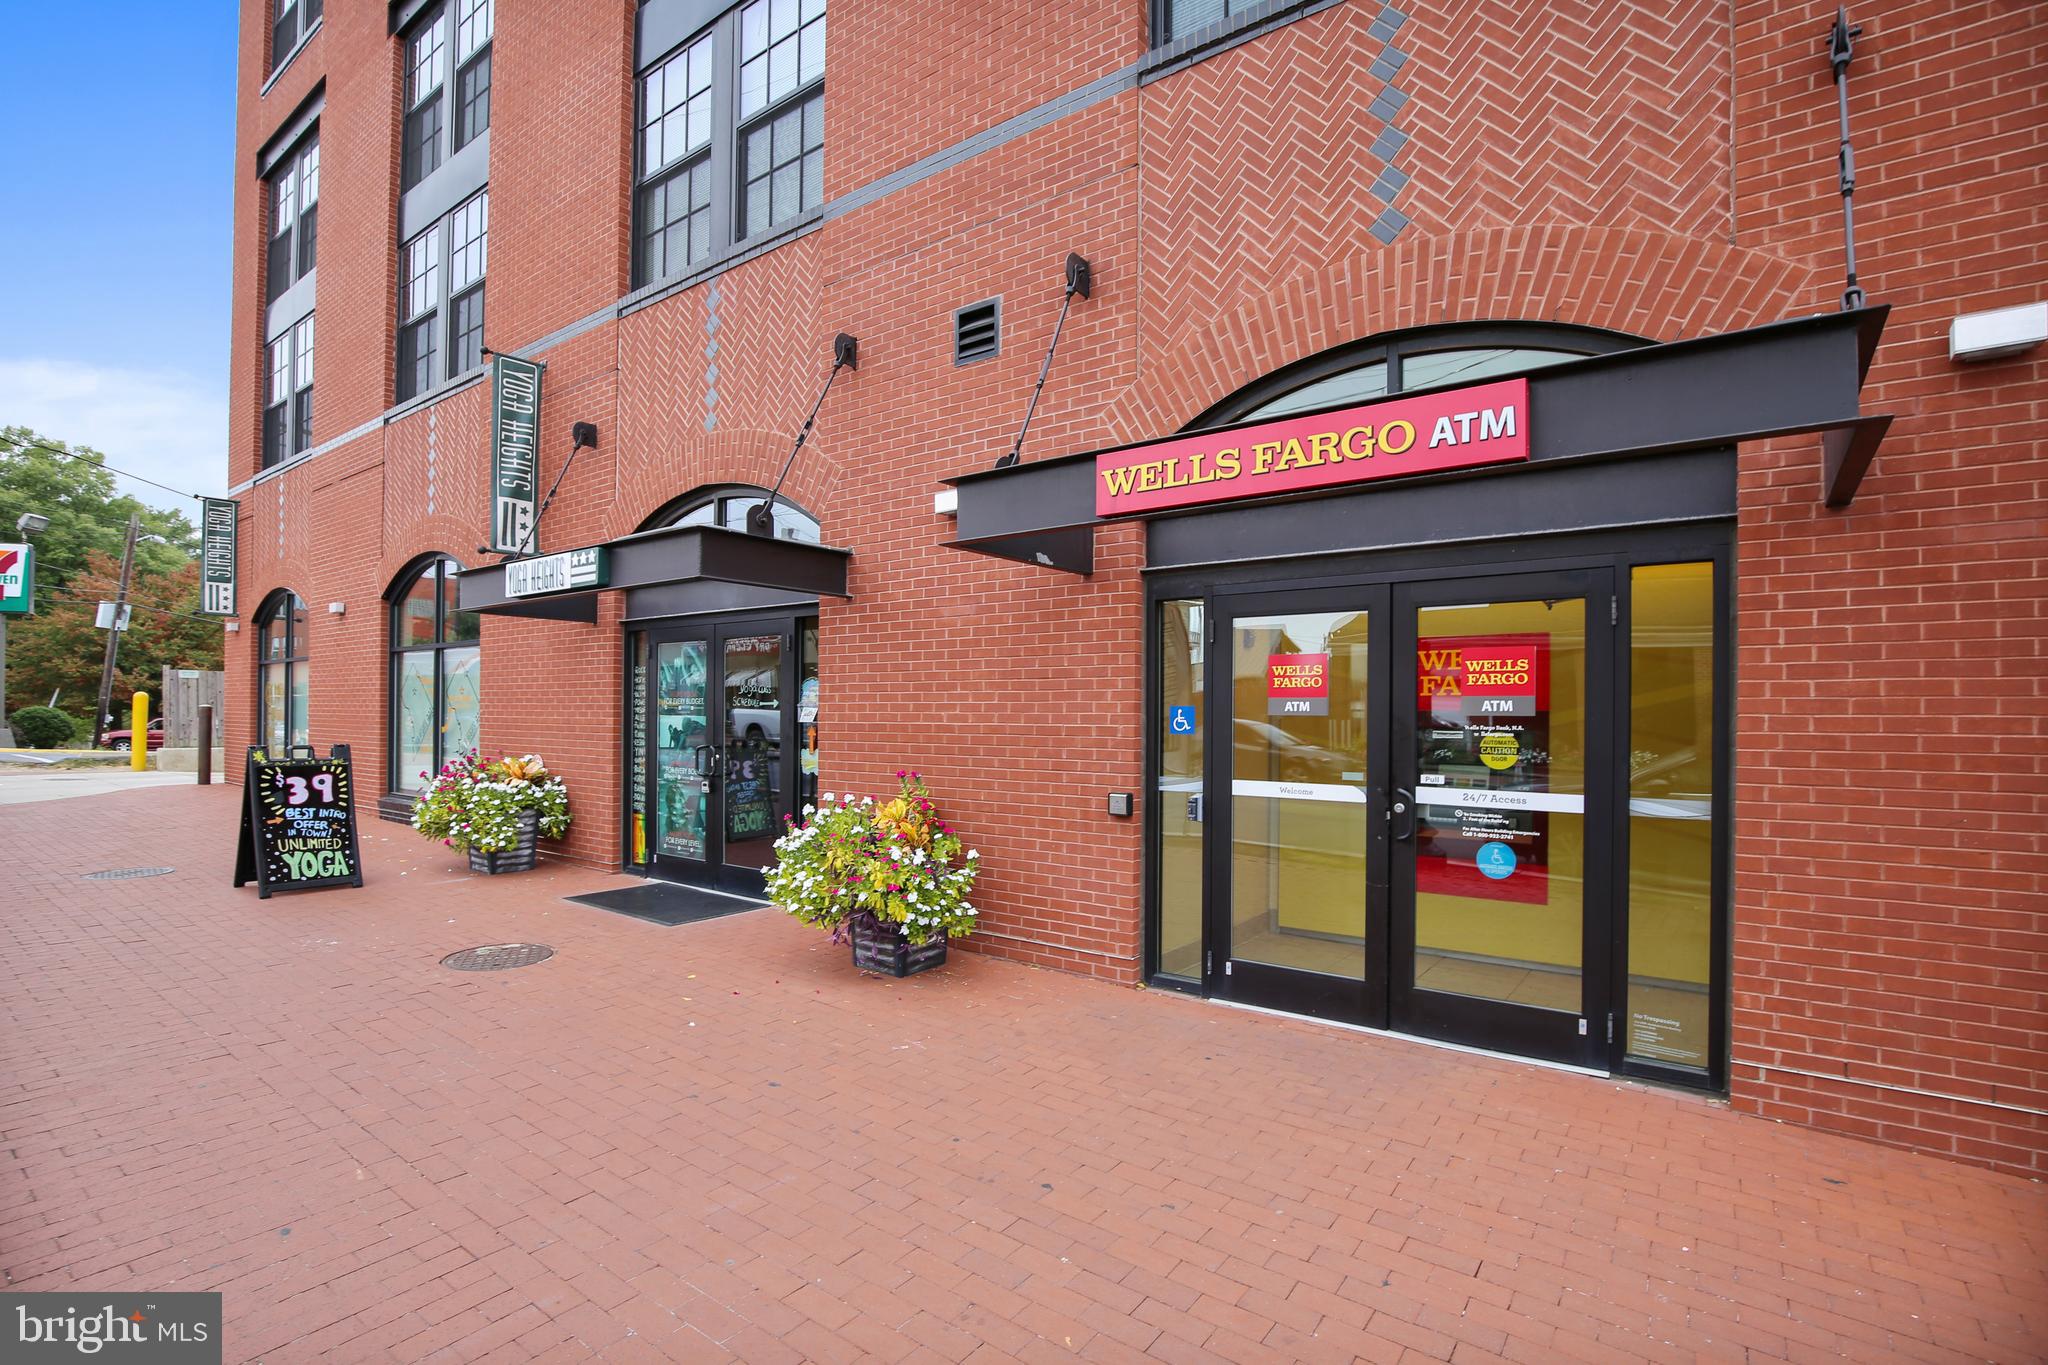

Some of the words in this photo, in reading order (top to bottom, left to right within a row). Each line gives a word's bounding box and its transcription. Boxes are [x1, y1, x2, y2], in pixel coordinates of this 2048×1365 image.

[502, 369, 534, 415] YOGA
[501, 418, 534, 492] HEIGHTS
[1101, 447, 1242, 497] WELLS
[1251, 419, 1418, 476] FARGO
[1428, 404, 1517, 449] ATM
[208, 505, 232, 532] YOGA
[207, 534, 232, 578] HEIGHTS
[508, 563, 528, 596] YOGA
[531, 556, 565, 592] HEIGHTS
[1271, 664, 1323, 676] WELLS
[1465, 659, 1529, 672] WELLS
[1272, 677, 1323, 688] FARGO
[1466, 673, 1529, 686] FARGO
[1284, 701, 1310, 712] ATM
[1481, 700, 1513, 712] ATM
[1480, 747, 1517, 755] CAUTION
[1279, 786, 1314, 796] Welcome
[1462, 792, 1488, 804] 24/7
[1490, 794, 1527, 805] Access
[285, 808, 316, 820] BEST
[318, 808, 347, 819] INTRO
[293, 820, 328, 830] OFFER
[301, 828, 333, 838] TOWN!
[277, 838, 342, 852] UNLIMITED
[281, 850, 350, 880] YOGA
